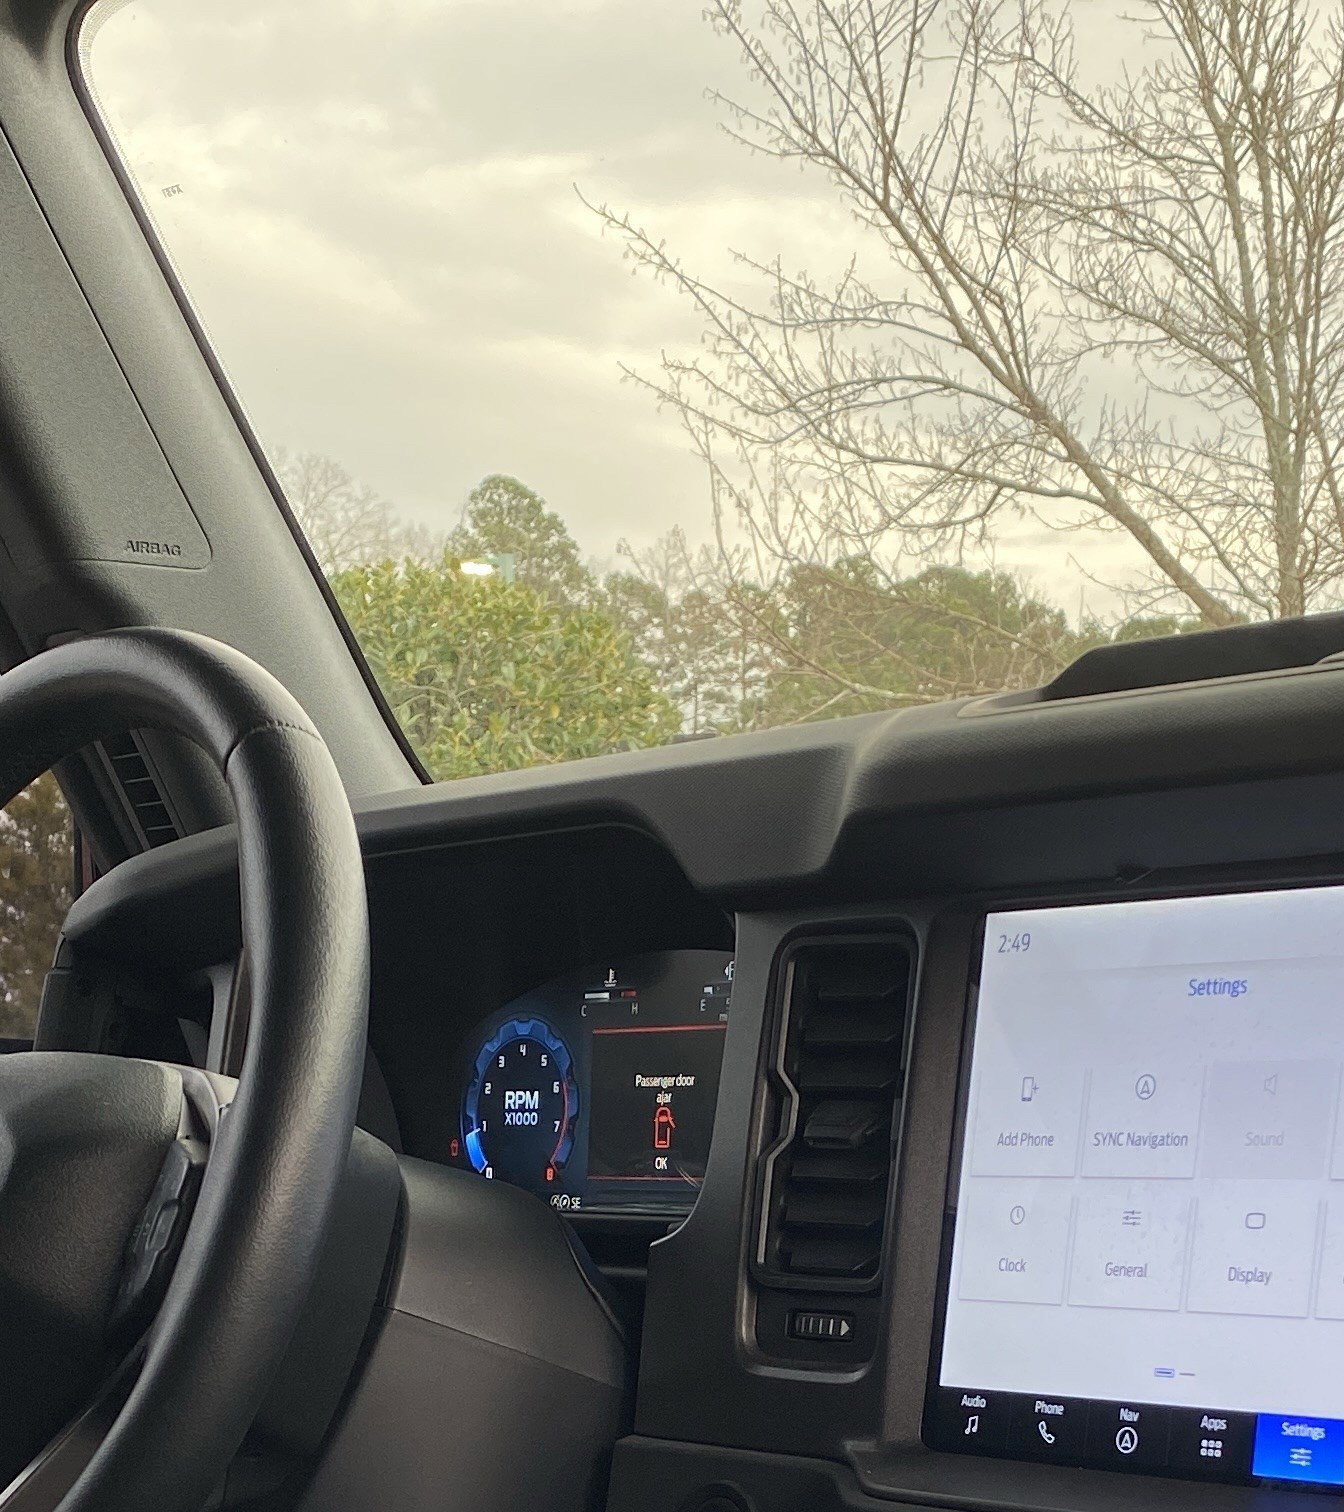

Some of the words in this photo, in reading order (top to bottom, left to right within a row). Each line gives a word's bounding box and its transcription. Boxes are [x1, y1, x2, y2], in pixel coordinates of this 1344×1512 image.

[126, 539, 182, 557] AIRBAG
[997, 932, 1031, 954] 2:49
[1188, 977, 1248, 998] Settings
[519, 1044, 527, 1057] 4
[498, 1055, 505, 1068] 3
[540, 1054, 548, 1067] 5
[553, 1081, 560, 1094] 6
[634, 1074, 675, 1088] Passenger
[675, 1073, 695, 1087] door
[484, 1082, 492, 1095] 2
[504, 1090, 540, 1110] RPM
[656, 1090, 672, 1105] ajar
[482, 1120, 487, 1132] 1
[504, 1112, 538, 1126] X1000
[553, 1120, 560, 1133] 7
[997, 1132, 1018, 1147] Add
[1019, 1131, 1054, 1146] Phone
[1093, 1132, 1124, 1147] SYNC
[1126, 1131, 1189, 1149] Navigation
[1244, 1130, 1284, 1147] Sound
[655, 1157, 668, 1170] OK
[998, 1257, 1027, 1273] Clock
[1105, 1262, 1148, 1278] General
[1228, 1266, 1272, 1286] Display
[961, 1394, 987, 1408] Audio
[1034, 1400, 1065, 1416] Phone
[1119, 1407, 1140, 1422] Nav
[1199, 1415, 1227, 1431] Apps
[1281, 1421, 1326, 1441] Settings
